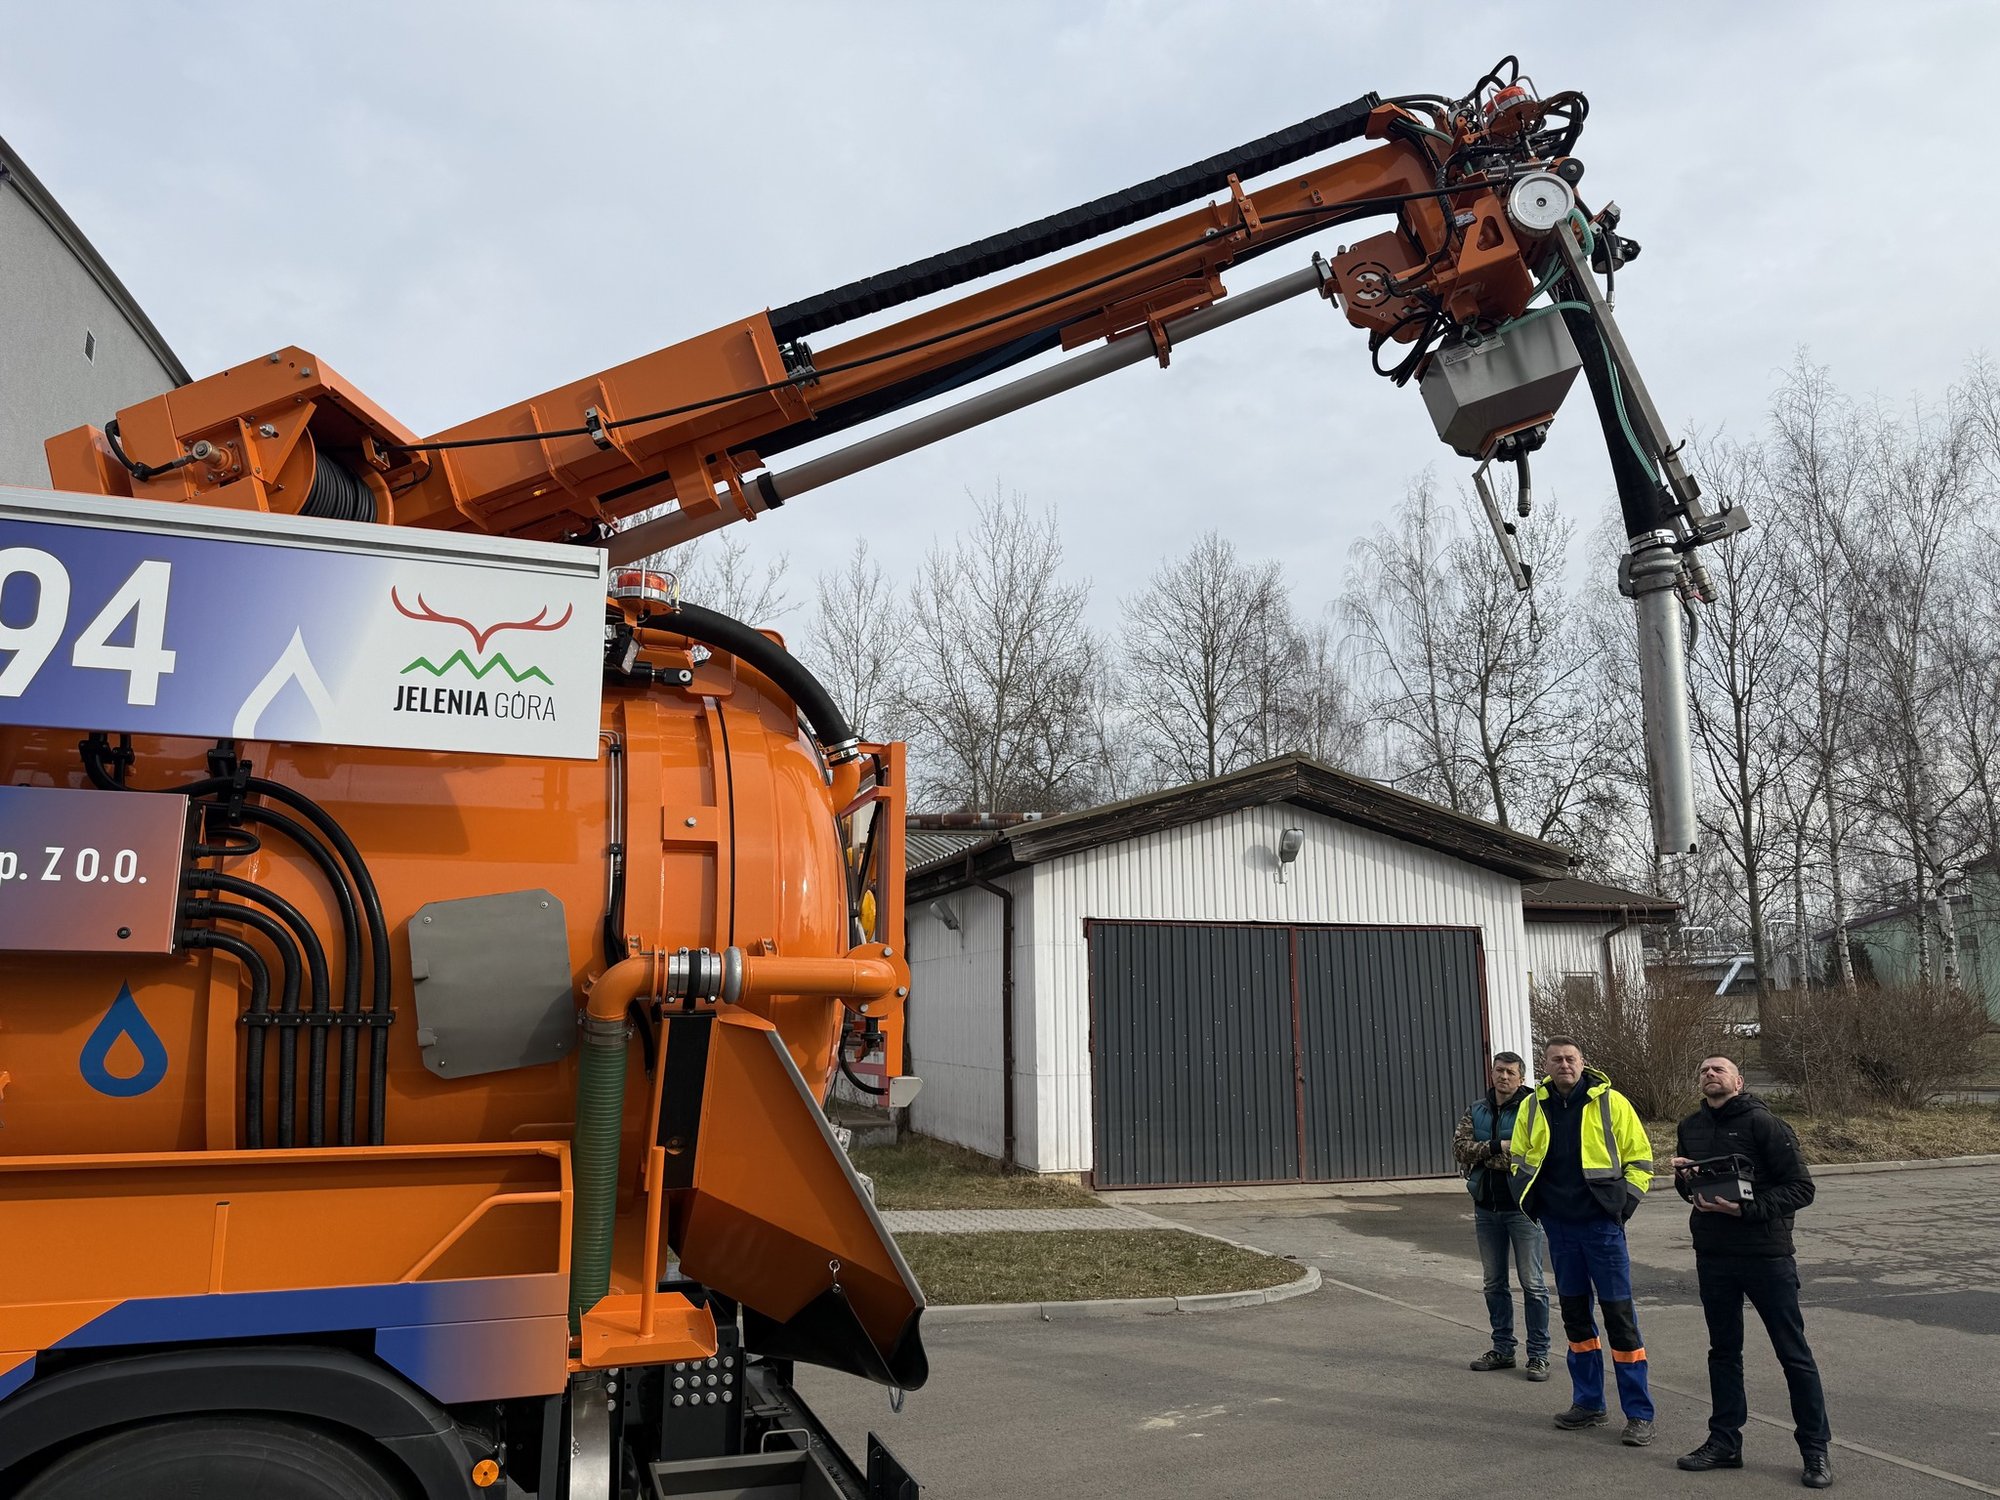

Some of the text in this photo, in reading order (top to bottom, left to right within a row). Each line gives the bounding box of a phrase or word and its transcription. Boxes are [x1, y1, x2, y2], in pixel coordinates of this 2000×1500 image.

[0, 547, 177, 706] 94
[393, 685, 556, 721] JELENIA GÓRA
